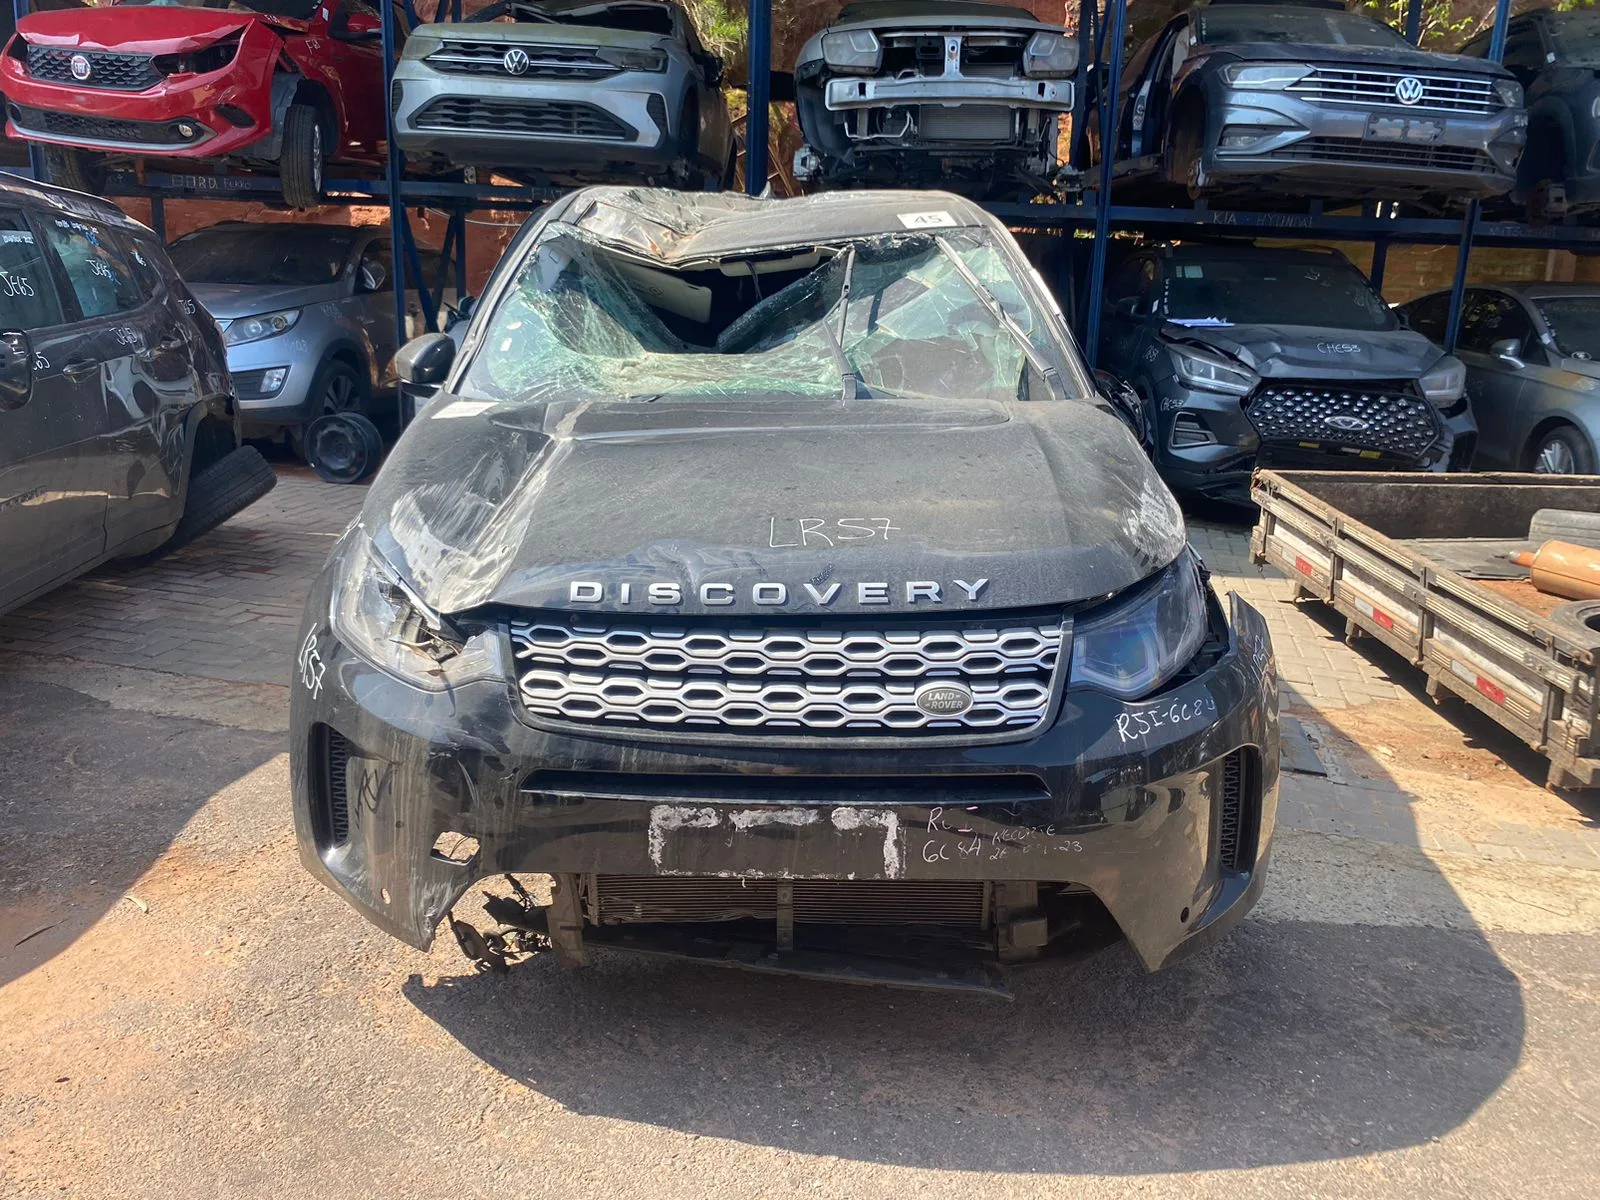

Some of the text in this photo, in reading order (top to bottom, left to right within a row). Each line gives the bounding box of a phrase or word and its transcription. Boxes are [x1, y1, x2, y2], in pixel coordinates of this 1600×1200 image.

[1213, 211, 1237, 225] KIA
[767, 516, 901, 549] LR57
[569, 578, 990, 606] DISCOVERY
[928, 692, 954, 701] LAND
[931, 701, 964, 709] ROVER
